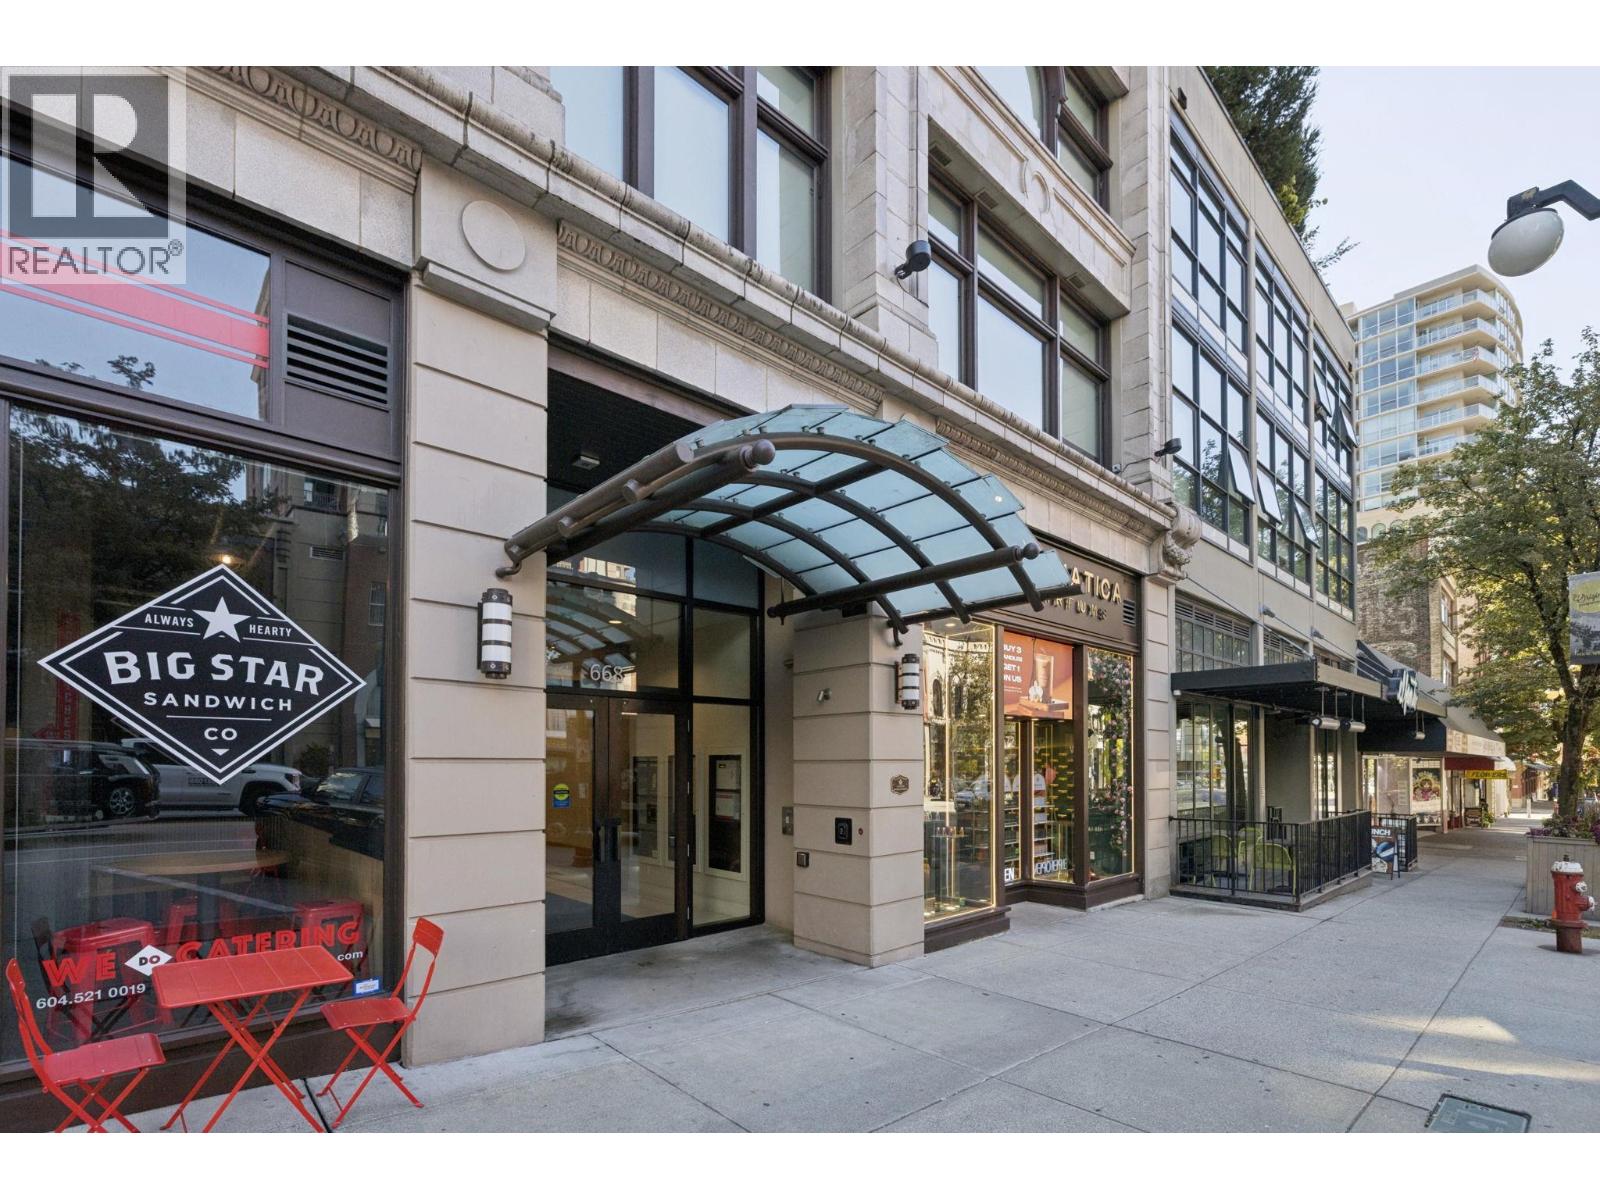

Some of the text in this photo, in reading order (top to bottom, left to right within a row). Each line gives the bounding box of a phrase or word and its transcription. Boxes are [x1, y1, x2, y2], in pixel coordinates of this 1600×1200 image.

[1064, 563, 1121, 603] ATICA
[144, 612, 293, 638] ALWAYS HEARTY
[103, 650, 325, 696] BIG STAR
[590, 663, 624, 683] 668
[143, 691, 293, 713] SANDWICH
[203, 727, 238, 741] CO
[42, 920, 362, 988] WE DO CATERING
[337, 950, 364, 962] com
[36, 982, 146, 1010] 604.521 0019
